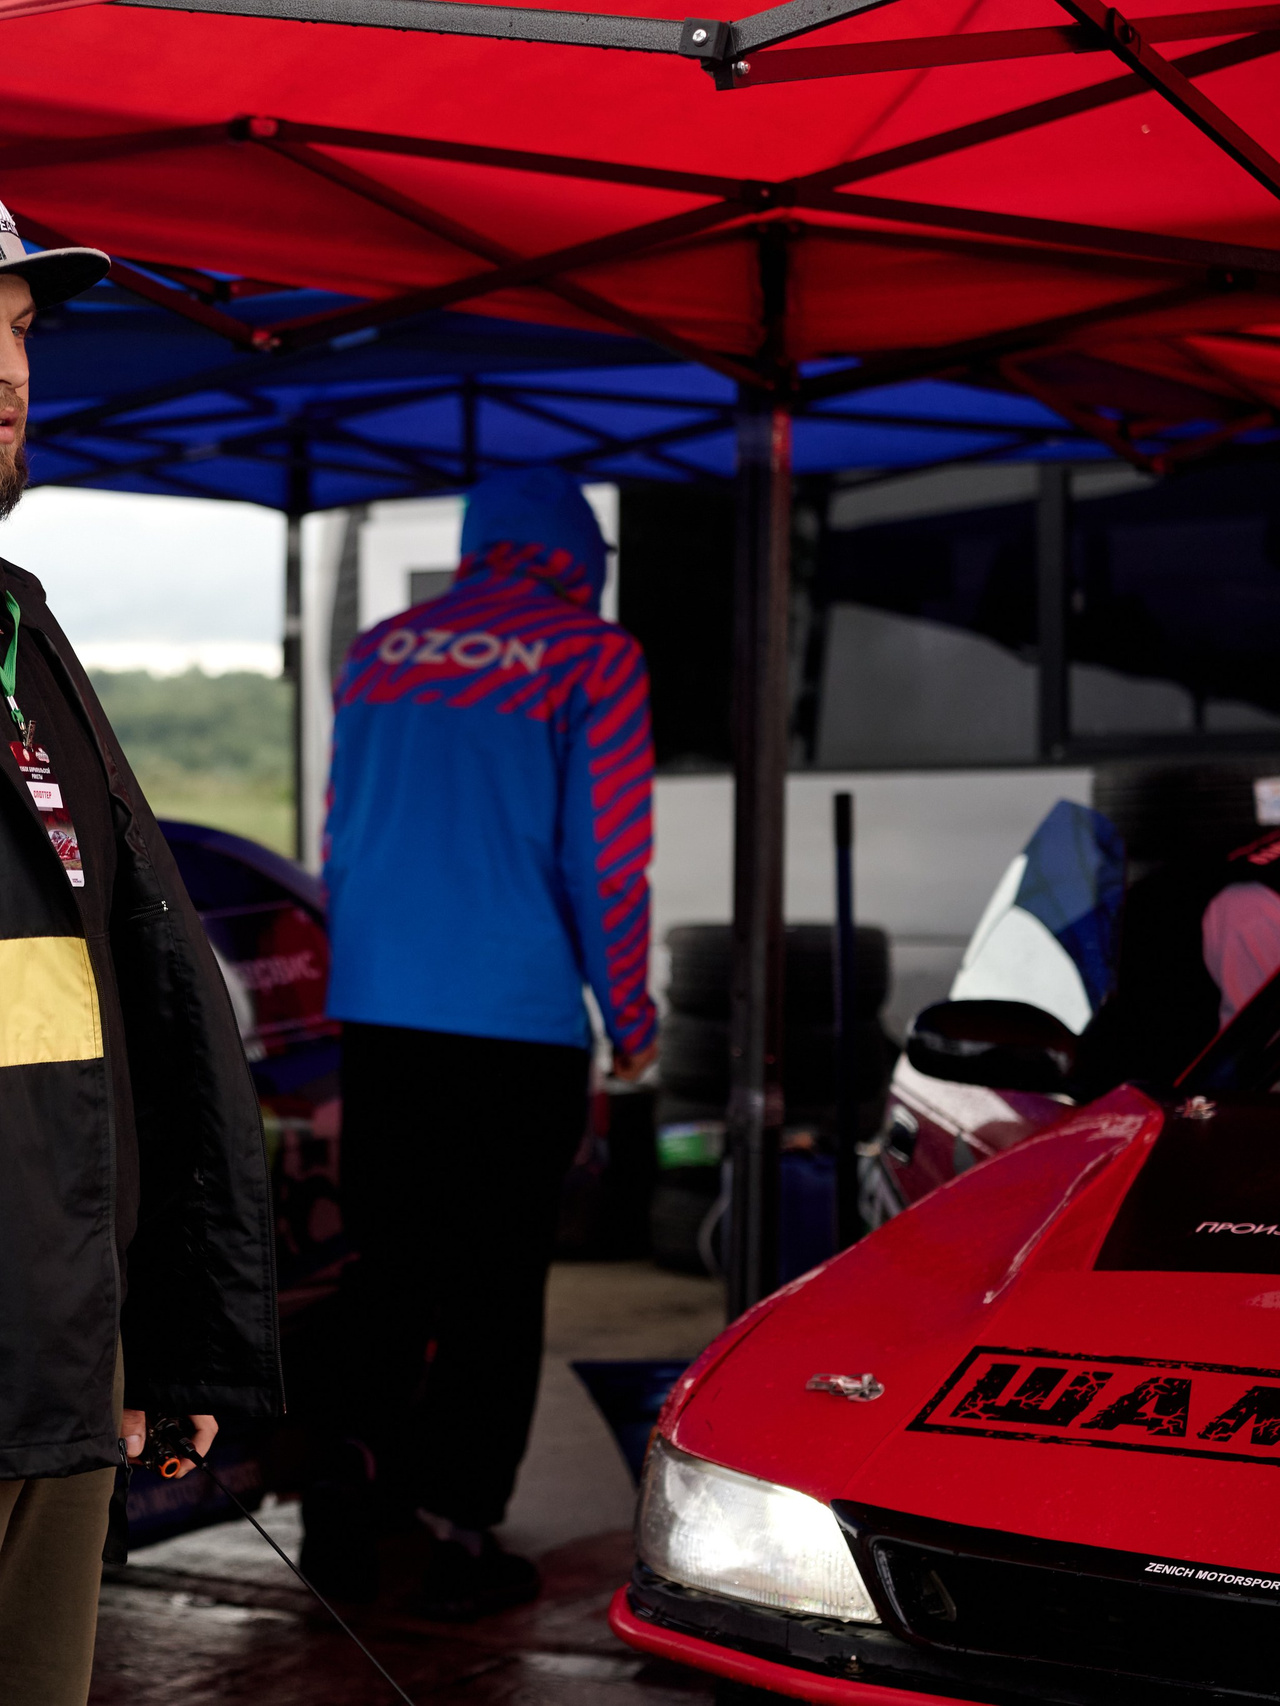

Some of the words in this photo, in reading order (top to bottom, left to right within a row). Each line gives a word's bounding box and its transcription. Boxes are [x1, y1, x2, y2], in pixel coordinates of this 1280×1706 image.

[379, 628, 548, 675] OZON
[1144, 1562, 1195, 1578] ZENICH
[1195, 1569, 1280, 1591] MOTORSPOR
